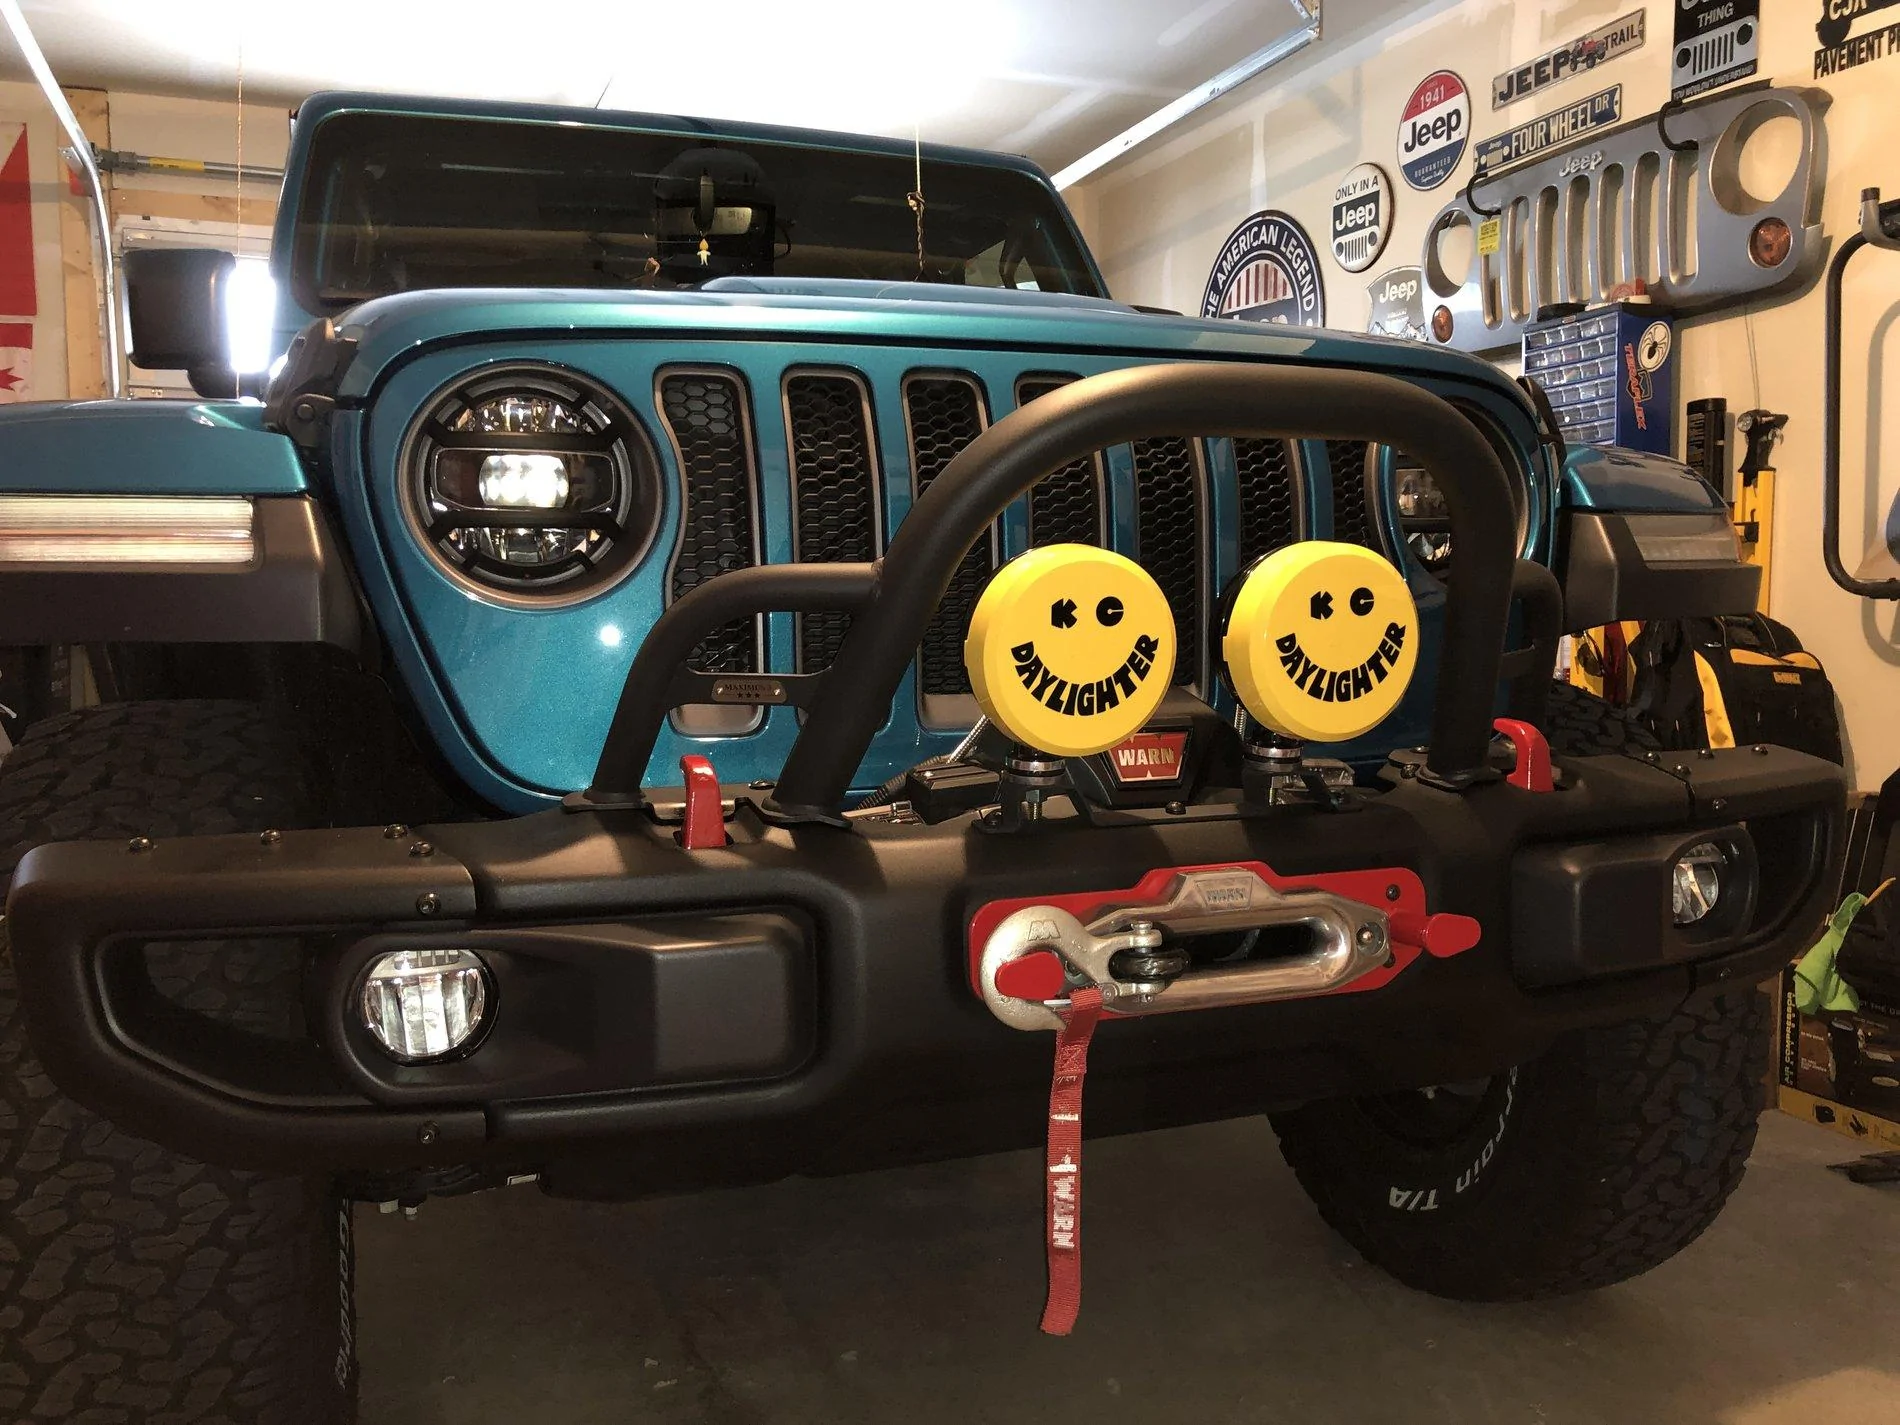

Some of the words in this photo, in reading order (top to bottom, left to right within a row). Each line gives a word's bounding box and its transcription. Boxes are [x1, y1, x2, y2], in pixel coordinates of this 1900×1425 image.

[1697, 2, 1734, 28] THING
[1499, 49, 1571, 102] JEEP
[1605, 24, 1638, 50] TRAIL
[1814, 29, 1884, 80] PAVEMENT
[1420, 84, 1445, 110] 1941
[1404, 108, 1462, 153] Jeep
[1511, 121, 1547, 158] FOUR
[1549, 101, 1596, 143] WHEEL
[1594, 93, 1610, 114] DR
[1559, 151, 1603, 177] Jeep
[1335, 183, 1358, 201] ONLY
[1359, 179, 1370, 192] IN
[1371, 175, 1379, 188] A
[1335, 202, 1376, 231] Jeep
[1206, 291, 1220, 319] HE
[1216, 224, 1279, 290] AMERICAN
[1279, 230, 1315, 312] LEGEND
[1379, 279, 1418, 304] Jeep
[1010, 634, 1160, 716] DAYLIGHTER
[1275, 622, 1406, 703] DAYLIGHTER
[1118, 747, 1175, 767] WARN
[1206, 887, 1246, 902] WARN
[1785, 991, 1793, 1063] COMPRESSOR
[1053, 1176, 1076, 1248] WARN
[1389, 1186, 1439, 1211] T/A
